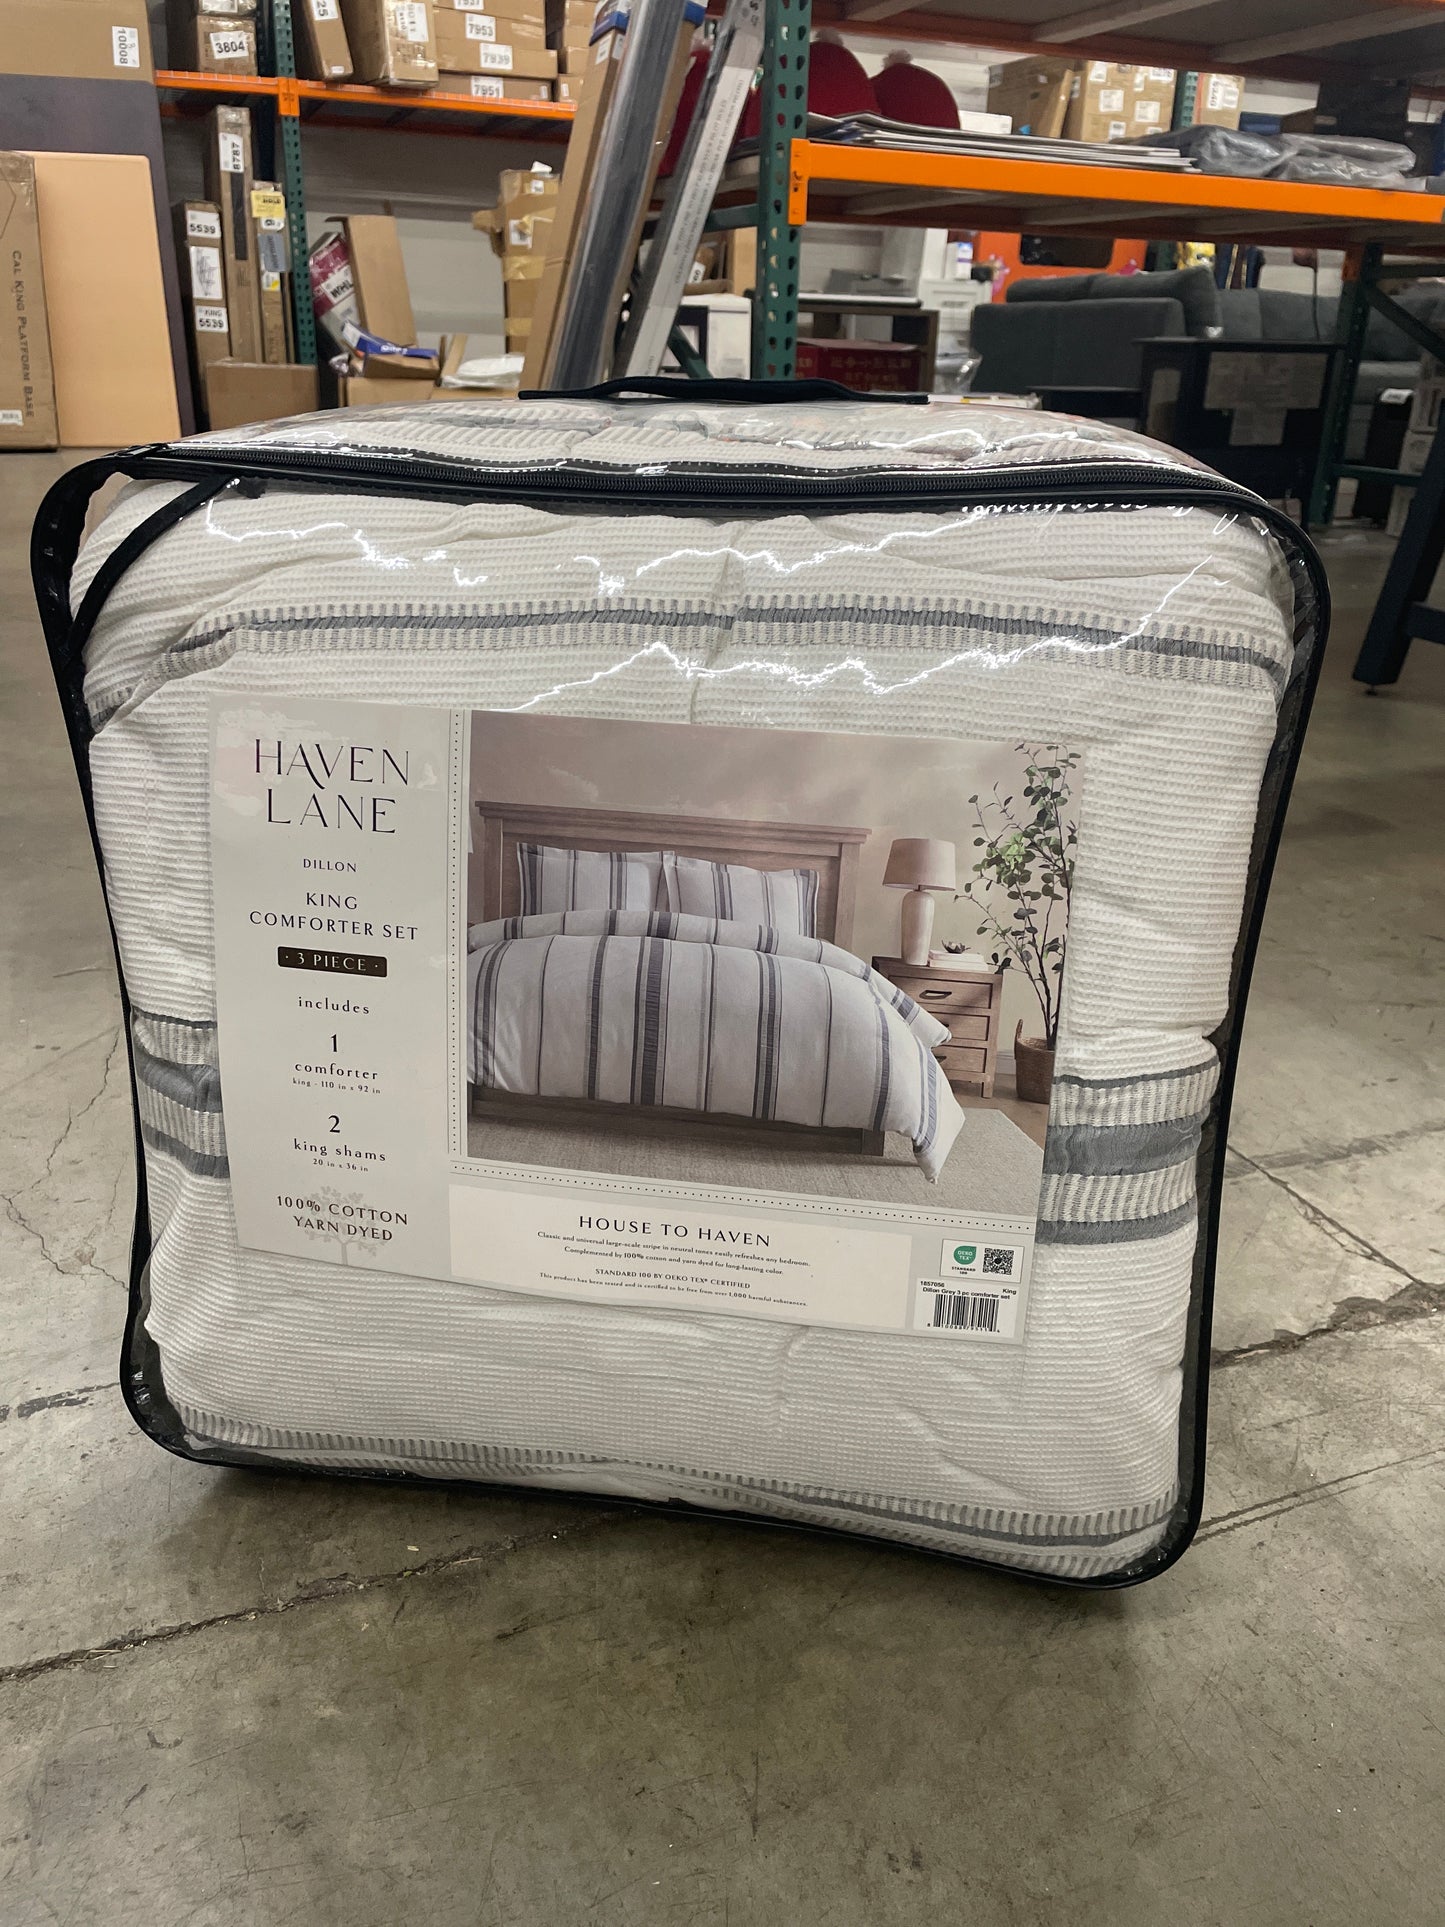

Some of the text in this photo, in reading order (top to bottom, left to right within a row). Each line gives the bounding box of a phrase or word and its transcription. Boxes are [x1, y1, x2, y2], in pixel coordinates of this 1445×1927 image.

[468, 23, 494, 37] 7953
[117, 28, 128, 65] 10008
[189, 223, 216, 234] 5539
[12, 250, 34, 417] CAL KING PLATFORM BASE
[198, 318, 225, 329] 5539
[255, 739, 409, 790] HAVEN
[267, 788, 396, 834] LANE
[303, 858, 358, 873] DILLON
[306, 892, 358, 911] KING
[249, 910, 419, 941] COMFORTER SET
[297, 952, 367, 972] 3 PIECE
[298, 996, 371, 1015] includes
[330, 1033, 338, 1053] 1
[294, 1062, 378, 1080] comforter
[292, 1077, 311, 1087] king
[321, 1080, 335, 1088] 110
[358, 1085, 369, 1093] 92
[328, 1114, 341, 1133] 2
[293, 1138, 386, 1161] king shams
[313, 1158, 323, 1166] 20
[346, 1162, 357, 1170] 36
[276, 1195, 408, 1225] 100% COTTON
[293, 1215, 393, 1241] YARN DYED
[579, 1215, 770, 1247] HOUSE TO HAVEN
[537, 1231, 561, 1240] Classic
[576, 1236, 605, 1245] universal
[606, 1239, 641, 1248] large-scale
[642, 1243, 661, 1251] stripe
[715, 1250, 733, 1258] easily
[734, 1252, 764, 1261] refreshes
[779, 1257, 811, 1267] bedroom.
[564, 1246, 613, 1258] Complemented
[698, 1259, 714, 1267] dyed
[725, 1262, 764, 1273] long-lasting
[553, 1274, 576, 1282] product
[728, 1291, 747, 1299] 1,000
[748, 1294, 771, 1302] harmful
[595, 1268, 637, 1278] STANDARD
[665, 1274, 688, 1282] OEKO
[710, 1279, 751, 1289] CERTIFIED
[970, 1291, 999, 1299] comforter
[1002, 1288, 1017, 1296] King
